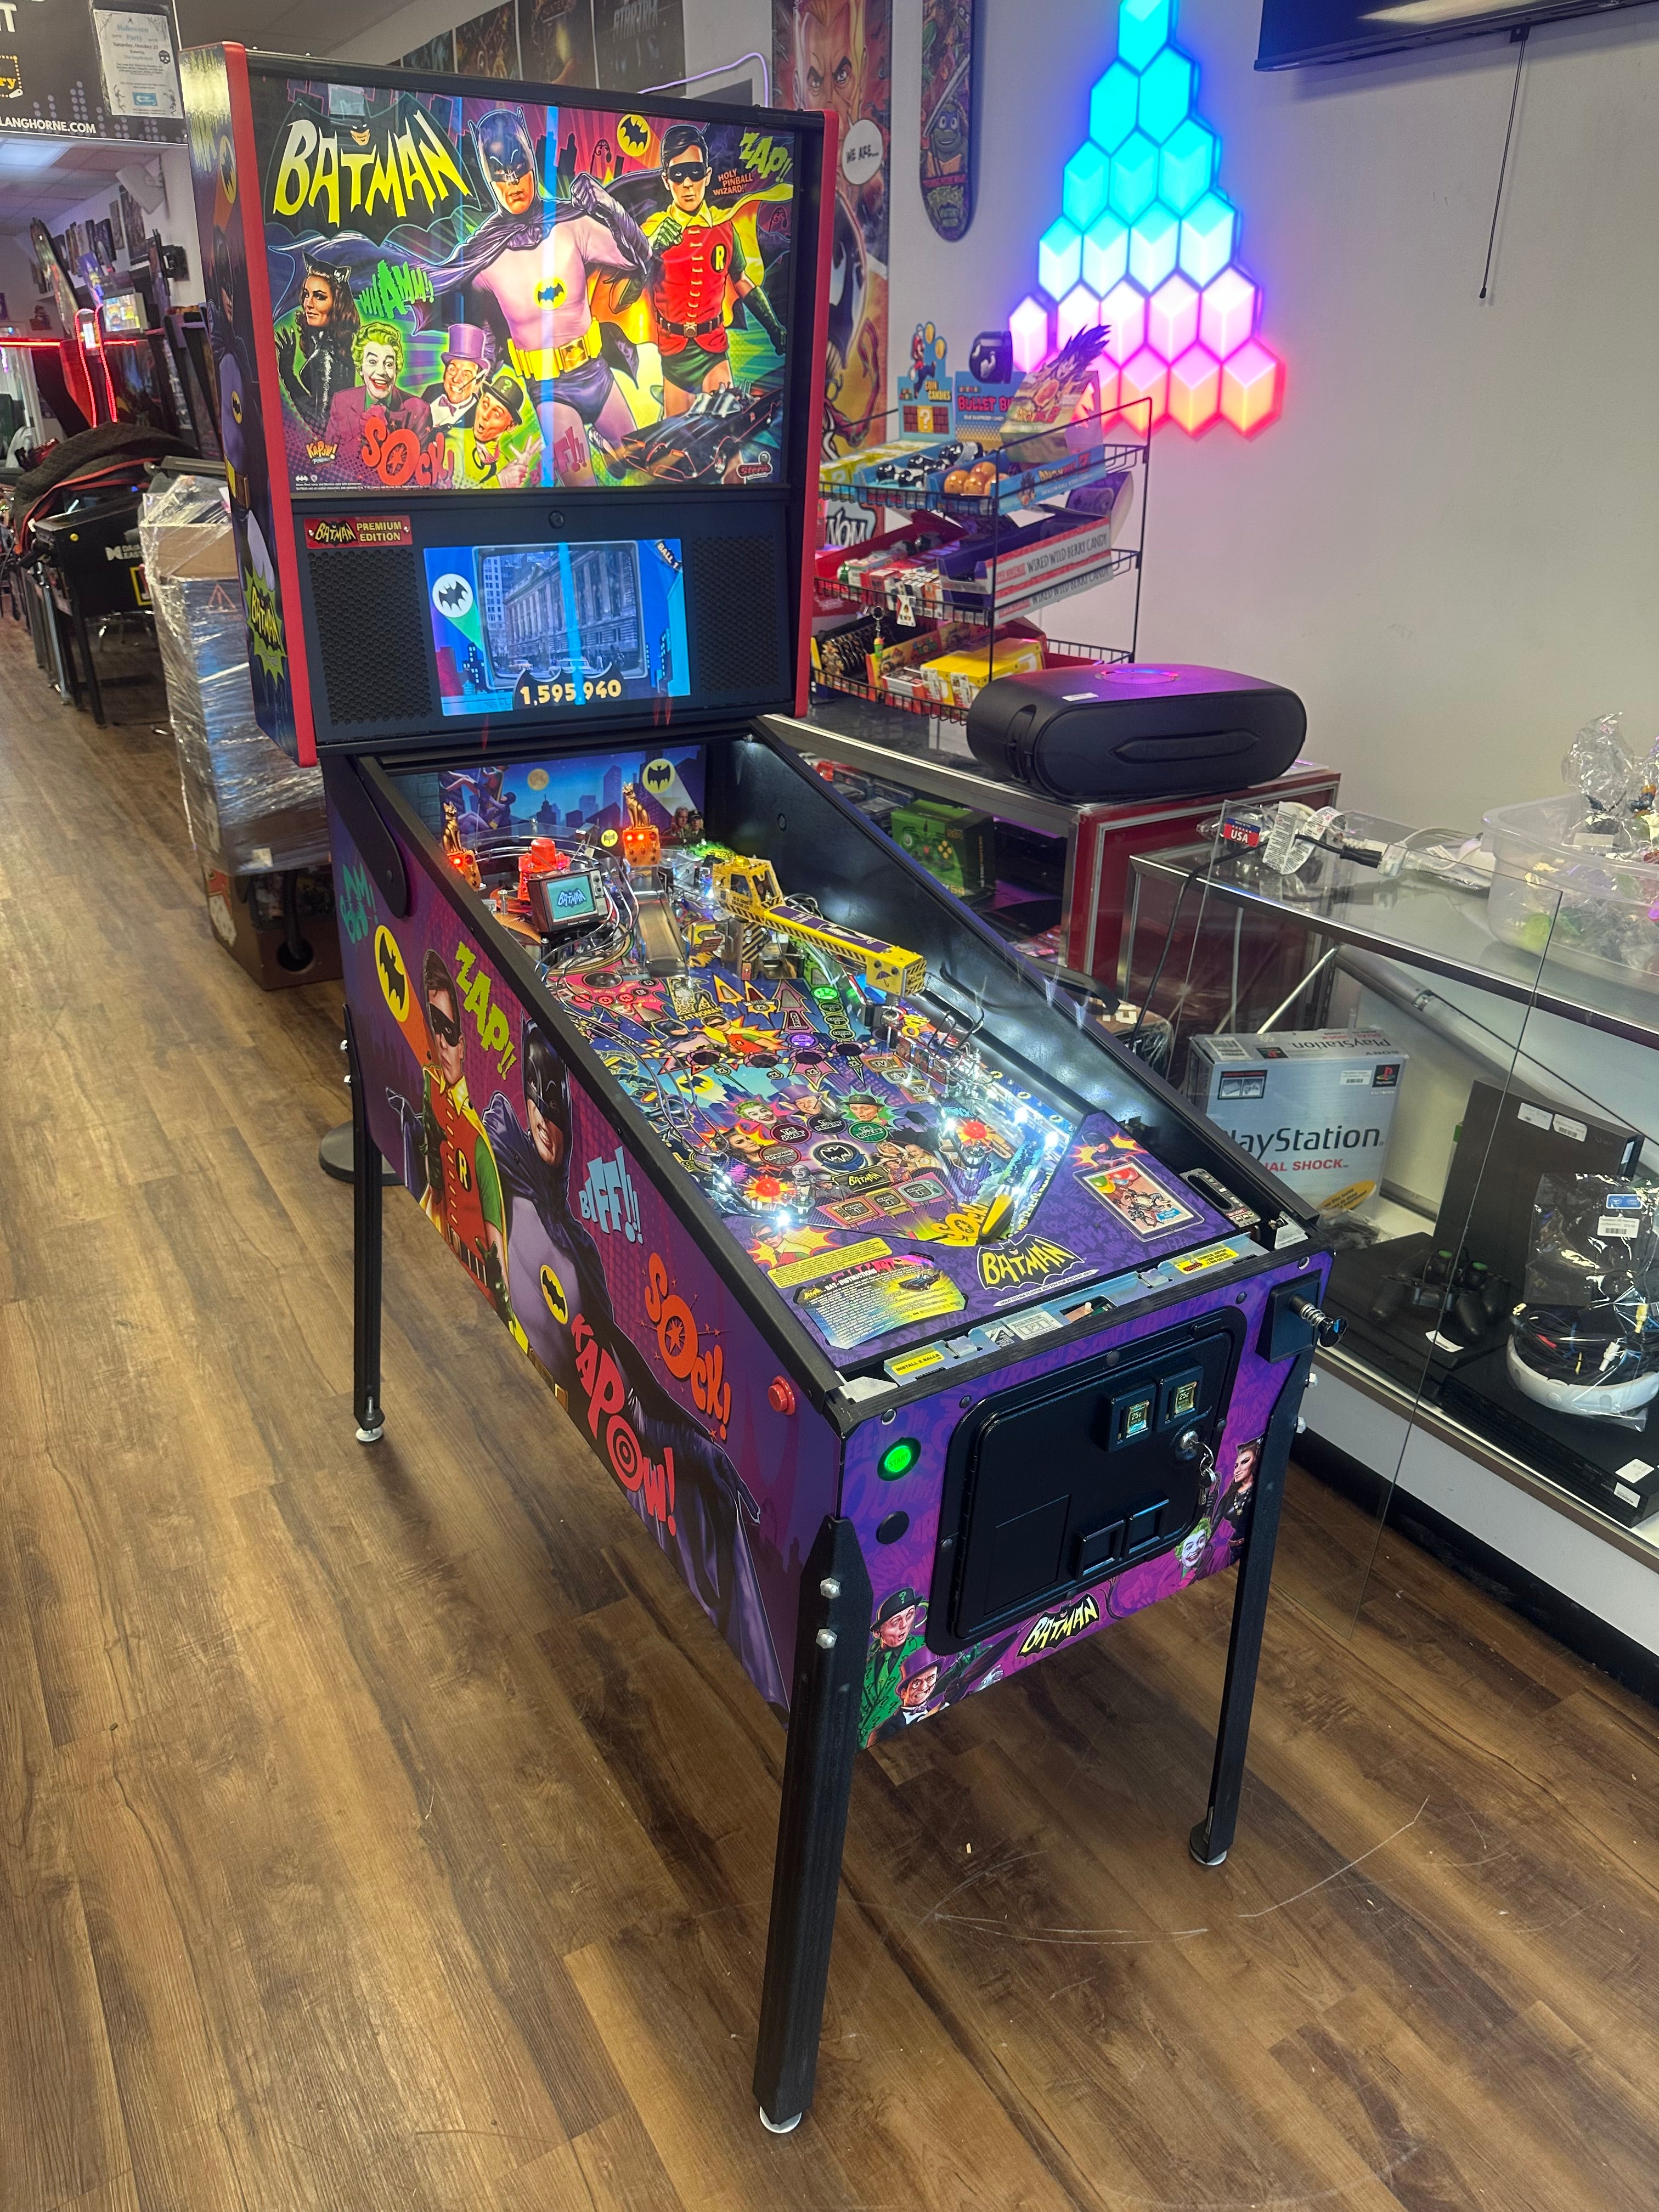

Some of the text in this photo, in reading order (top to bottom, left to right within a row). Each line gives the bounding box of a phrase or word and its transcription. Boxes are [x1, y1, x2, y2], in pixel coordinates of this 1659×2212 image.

[738, 132, 793, 183] ZAP!!
[846, 148, 856, 163] WE
[273, 110, 473, 228] BATMAN
[718, 168, 737, 182] HOLY
[722, 174, 753, 188] PINBALL
[713, 184, 745, 196] WIZARD!
[957, 395, 996, 411] BULLET
[314, 522, 357, 544] BATMAN
[356, 521, 402, 532] PREMIUM
[359, 532, 401, 542] EDITION
[657, 541, 675, 563] BALL
[1027, 533, 1108, 573] WIRED WILD BERRY CANDY
[520, 679, 622, 706] 1,595940
[1231, 829, 1249, 844] USA
[557, 889, 586, 906] BATMAN
[950, 884, 966, 896] 64
[455, 940, 517, 1081] ZAP!!
[679, 1006, 724, 1023] CATWOMAN
[1293, 1037, 1391, 1049] PlayStation
[816, 1121, 843, 1131] PENGUIN
[857, 1128, 882, 1138] RIDDLER
[782, 1131, 804, 1141] JOKER
[1224, 1125, 1380, 1161] layStation
[765, 1150, 794, 1160] CATWOMAN
[1292, 1159, 1343, 1171] SHOCK
[849, 1171, 883, 1186] BATMAN
[981, 1238, 1075, 1285] BATMAN
[895, 1362, 919, 1372] INSTALL
[922, 1353, 940, 1362] BALLS
[1179, 1392, 1189, 1400] 25¢
[1131, 1410, 1142, 1420] 25¢
[571, 1313, 676, 1536] KAPOW!
[889, 1452, 909, 1468] START
[1022, 1596, 1098, 1653] BATMAN
